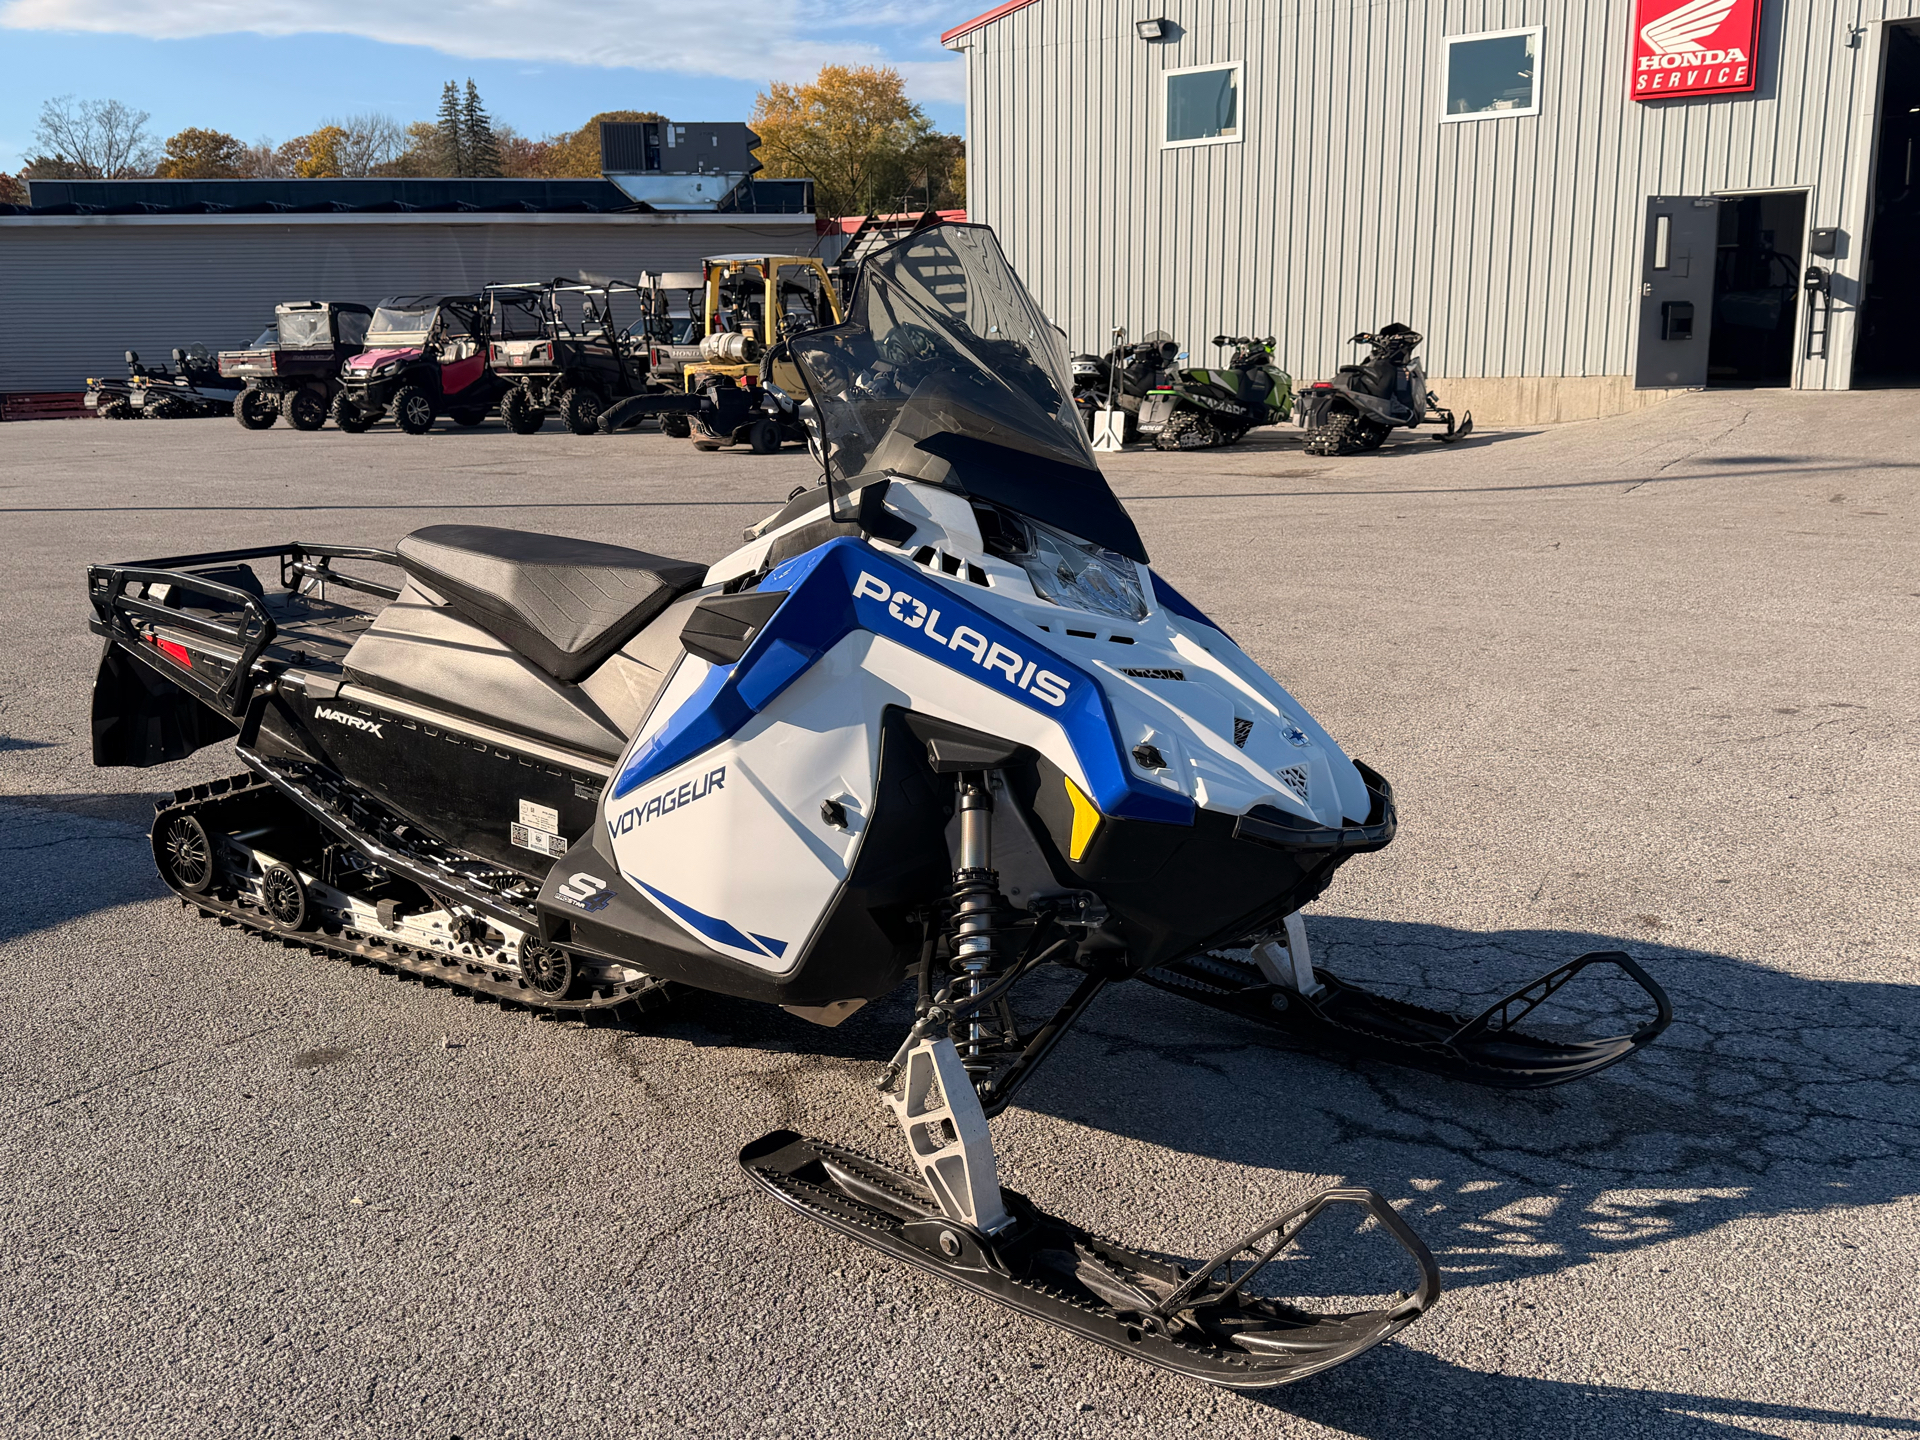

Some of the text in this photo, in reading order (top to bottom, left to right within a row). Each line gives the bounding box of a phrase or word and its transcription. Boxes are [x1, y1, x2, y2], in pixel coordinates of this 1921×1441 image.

[1638, 48, 1748, 71] HONDA
[1637, 66, 1747, 90] SERVICE
[852, 570, 1071, 707] POLARIS
[314, 705, 384, 740] MATRYX
[608, 765, 726, 839] VOYAGEUR
